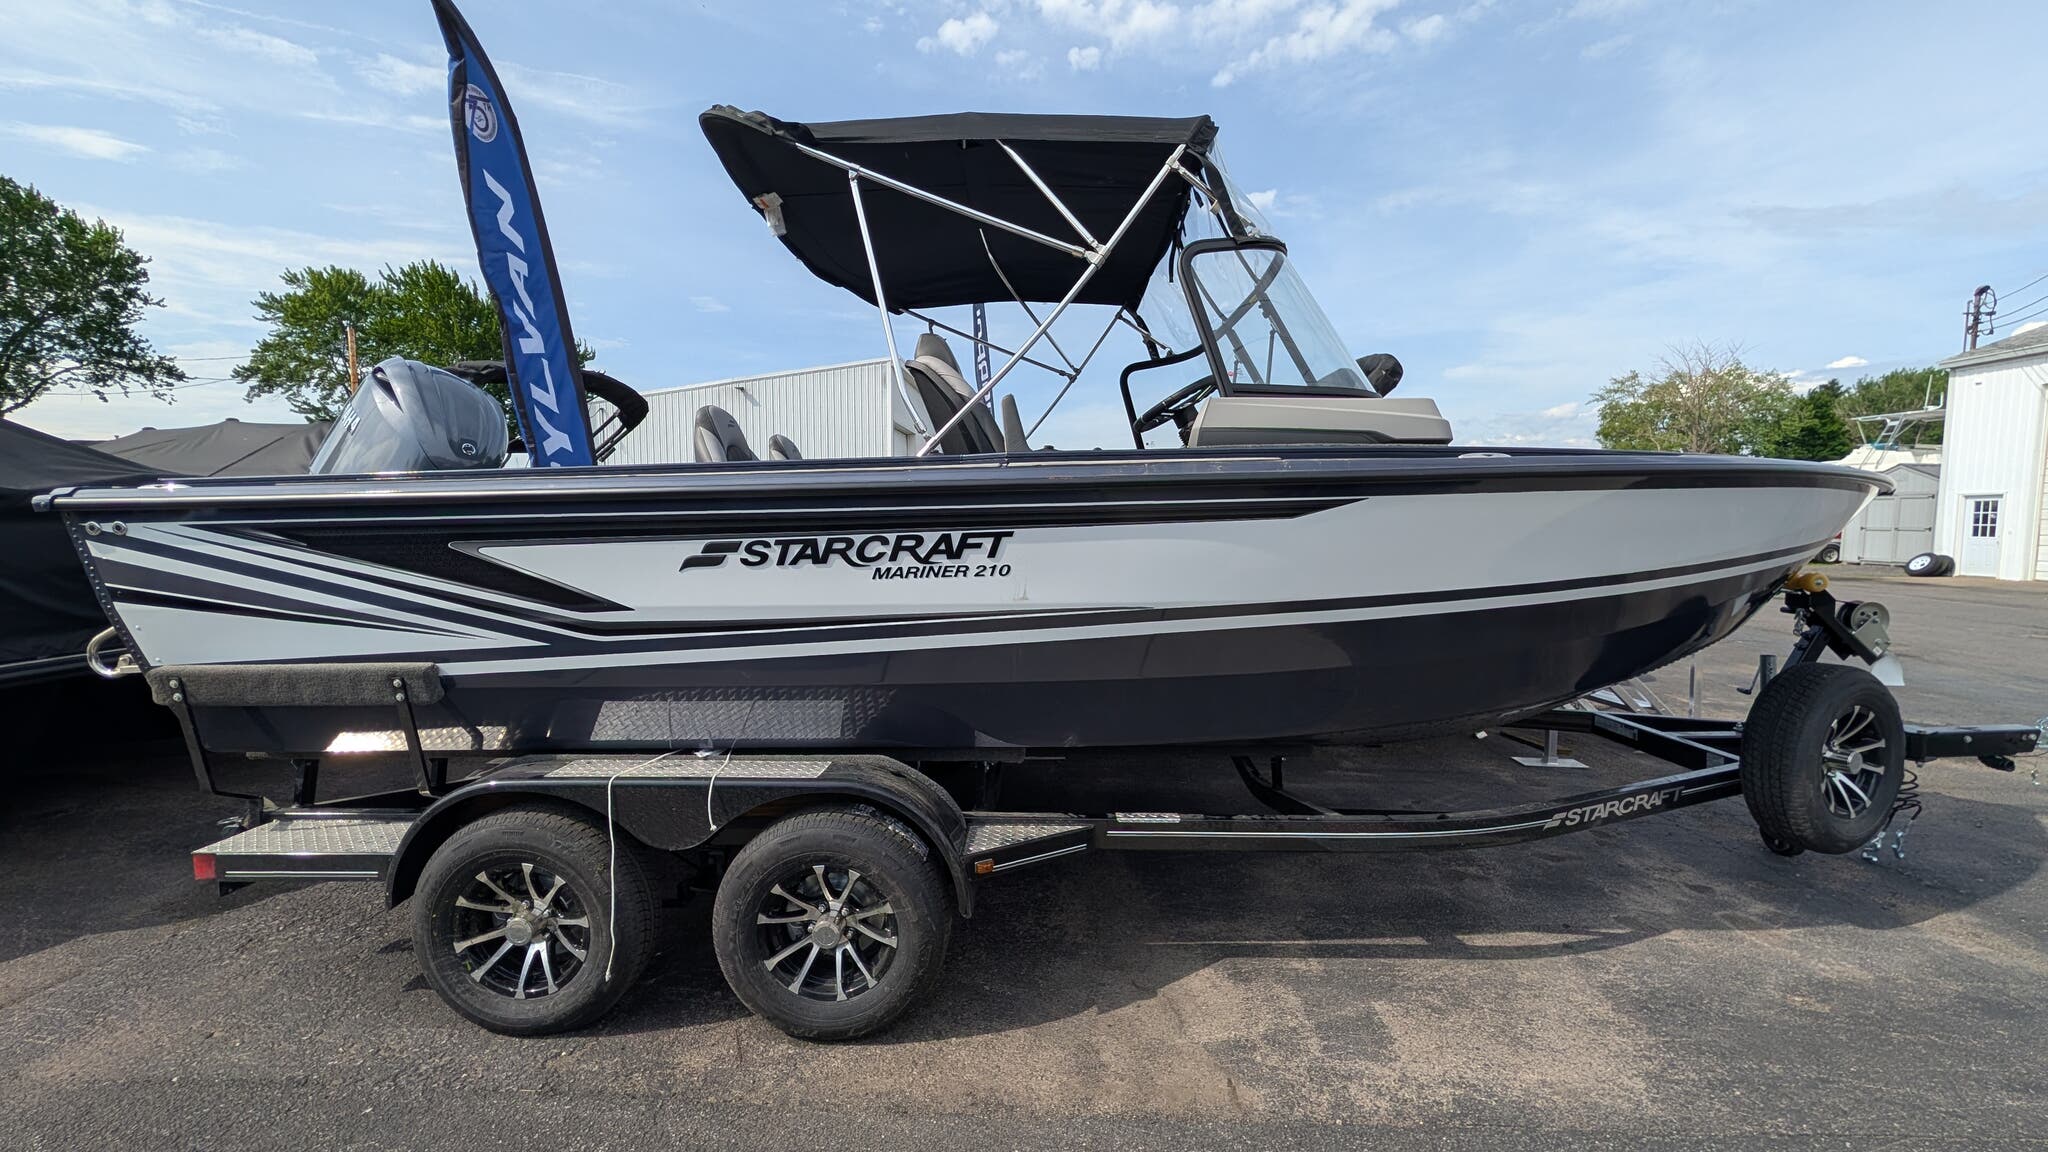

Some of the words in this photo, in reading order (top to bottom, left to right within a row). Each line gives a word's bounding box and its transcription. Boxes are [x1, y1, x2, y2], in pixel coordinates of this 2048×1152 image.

[482, 168, 574, 467] YLVAN
[739, 530, 1015, 568] STARCRAFT
[871, 565, 972, 580] MARINER
[974, 563, 1012, 578] 210
[1564, 786, 1685, 827] STARCRAFT
